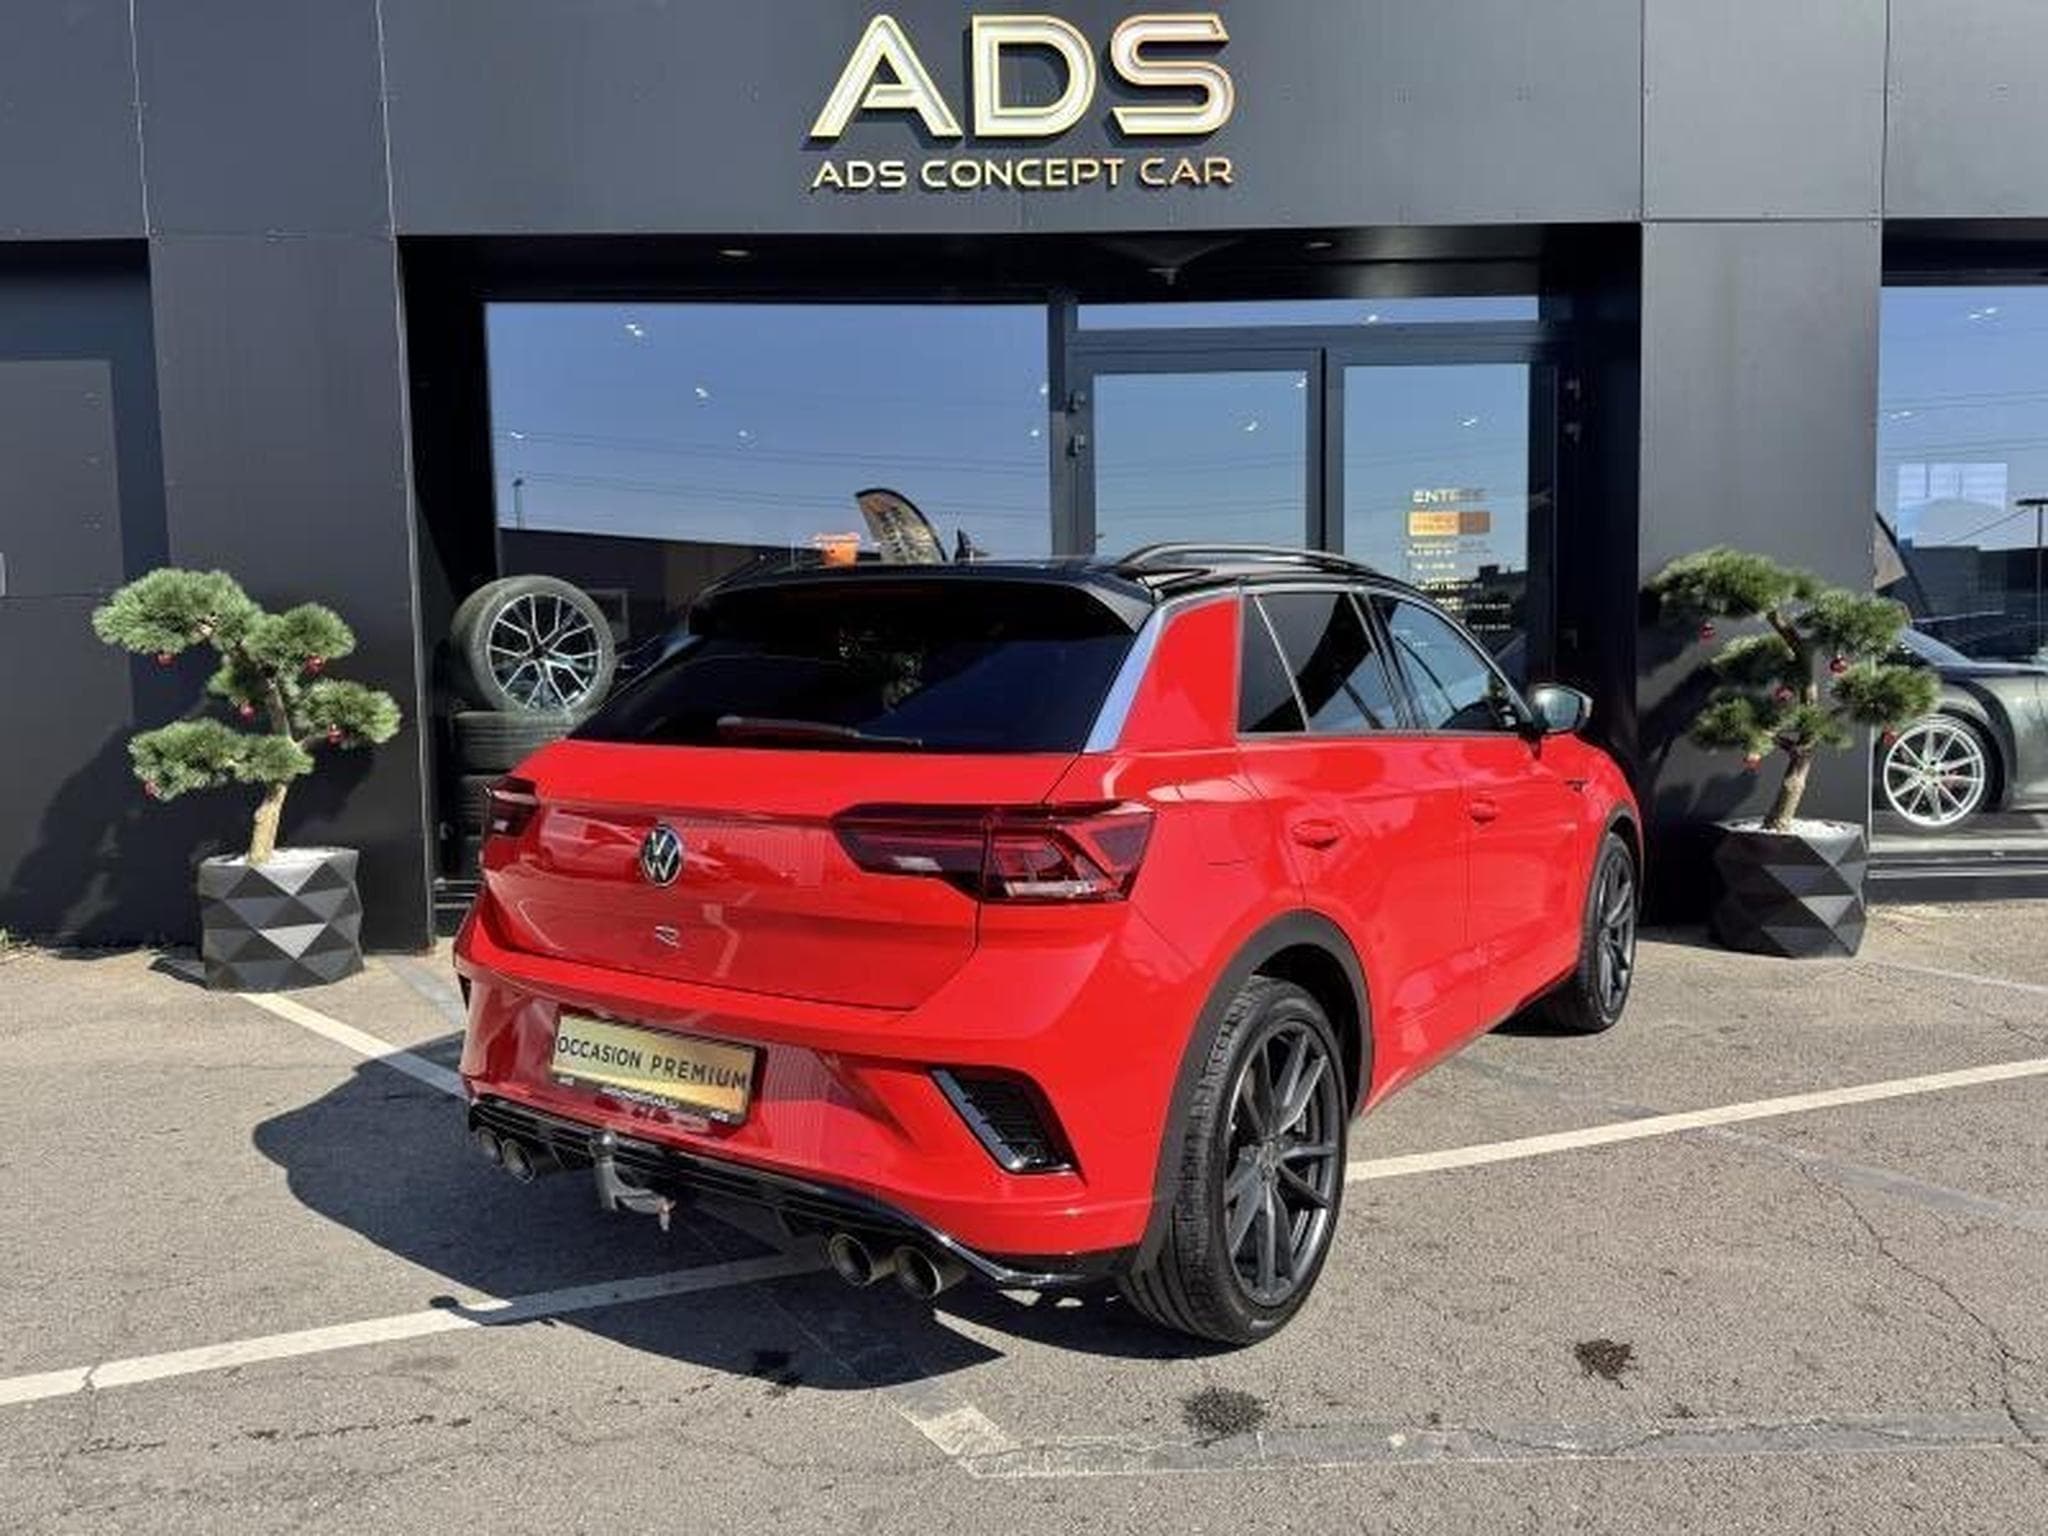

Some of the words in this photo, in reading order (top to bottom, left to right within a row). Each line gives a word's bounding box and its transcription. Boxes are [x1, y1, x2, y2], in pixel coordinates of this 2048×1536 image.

[809, 13, 1236, 138] ADS
[812, 159, 906, 189] ADS
[920, 158, 1125, 188] CONCEPT
[1139, 156, 1234, 186] CAR
[556, 1035, 642, 1070] OCCASION
[651, 1053, 749, 1090] PREMIUM
